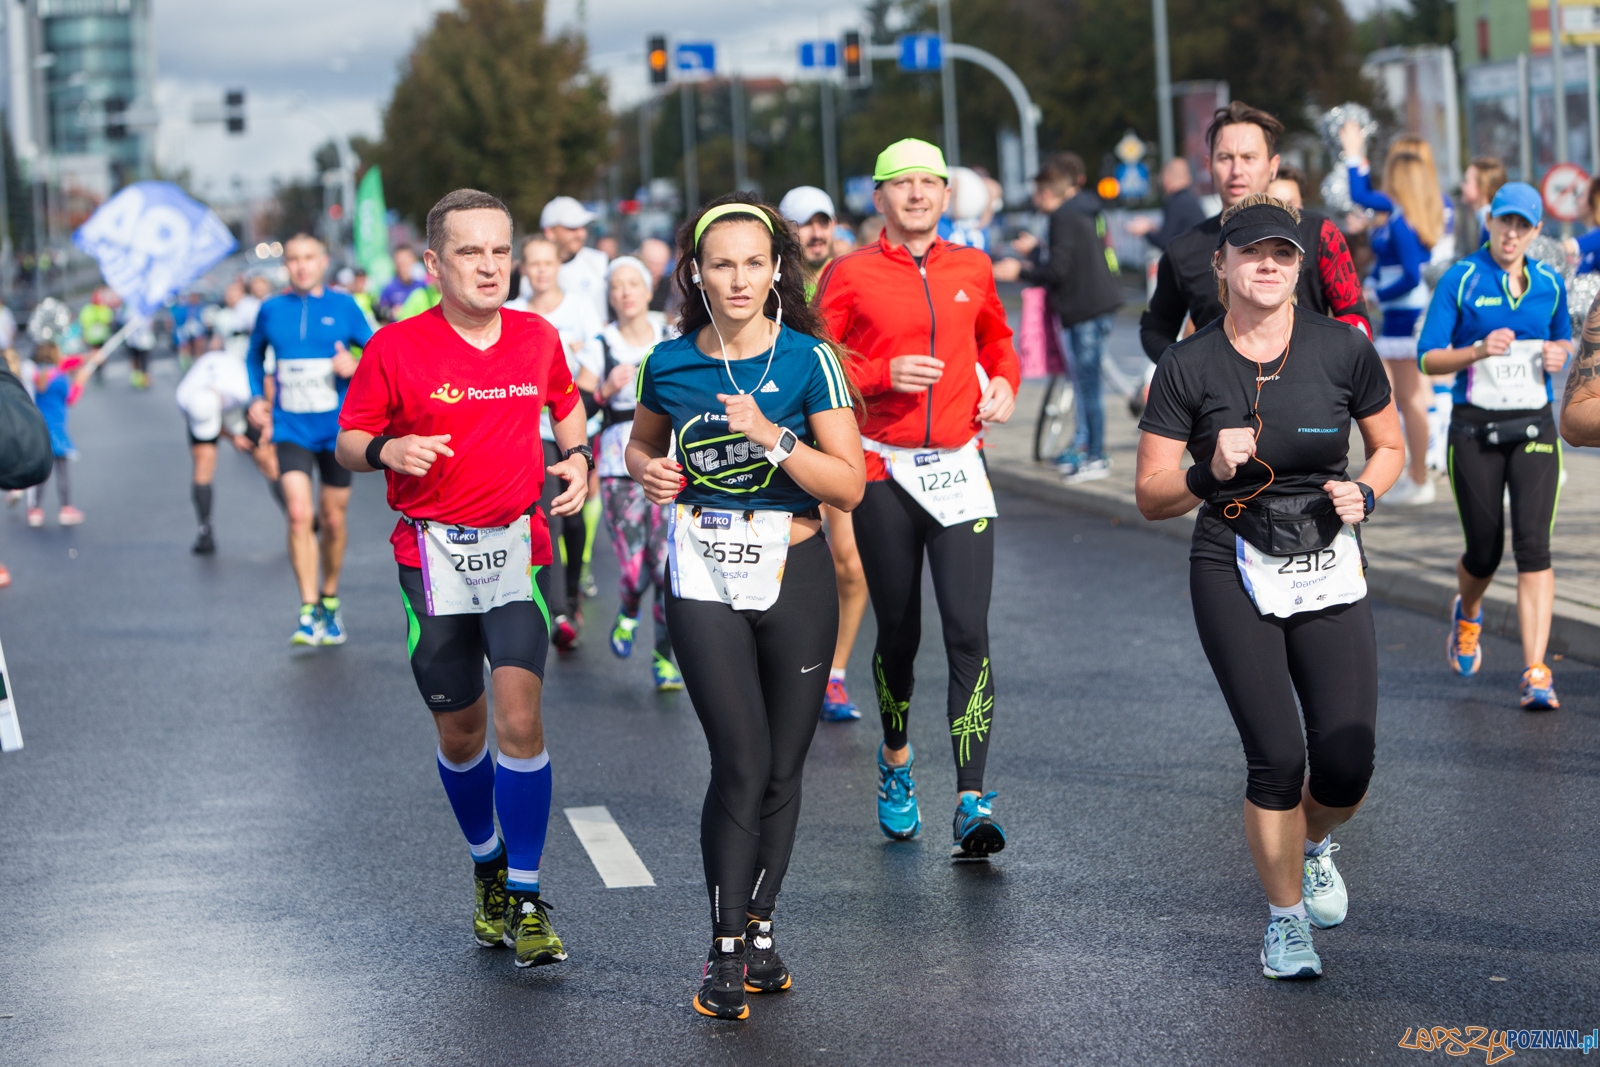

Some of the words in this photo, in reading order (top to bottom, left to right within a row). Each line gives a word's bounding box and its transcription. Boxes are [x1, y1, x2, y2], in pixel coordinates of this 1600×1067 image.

[1495, 364, 1527, 379] 1371
[467, 387, 507, 400] Poczta
[509, 382, 539, 397] Polska
[736, 473, 753, 483] 1979
[918, 469, 968, 492] 1224
[451, 549, 508, 573] 2618
[698, 540, 763, 565] 2635
[1278, 549, 1337, 575] 2312
[465, 574, 501, 587] Dariusz
[1290, 575, 1328, 589] Joanna
